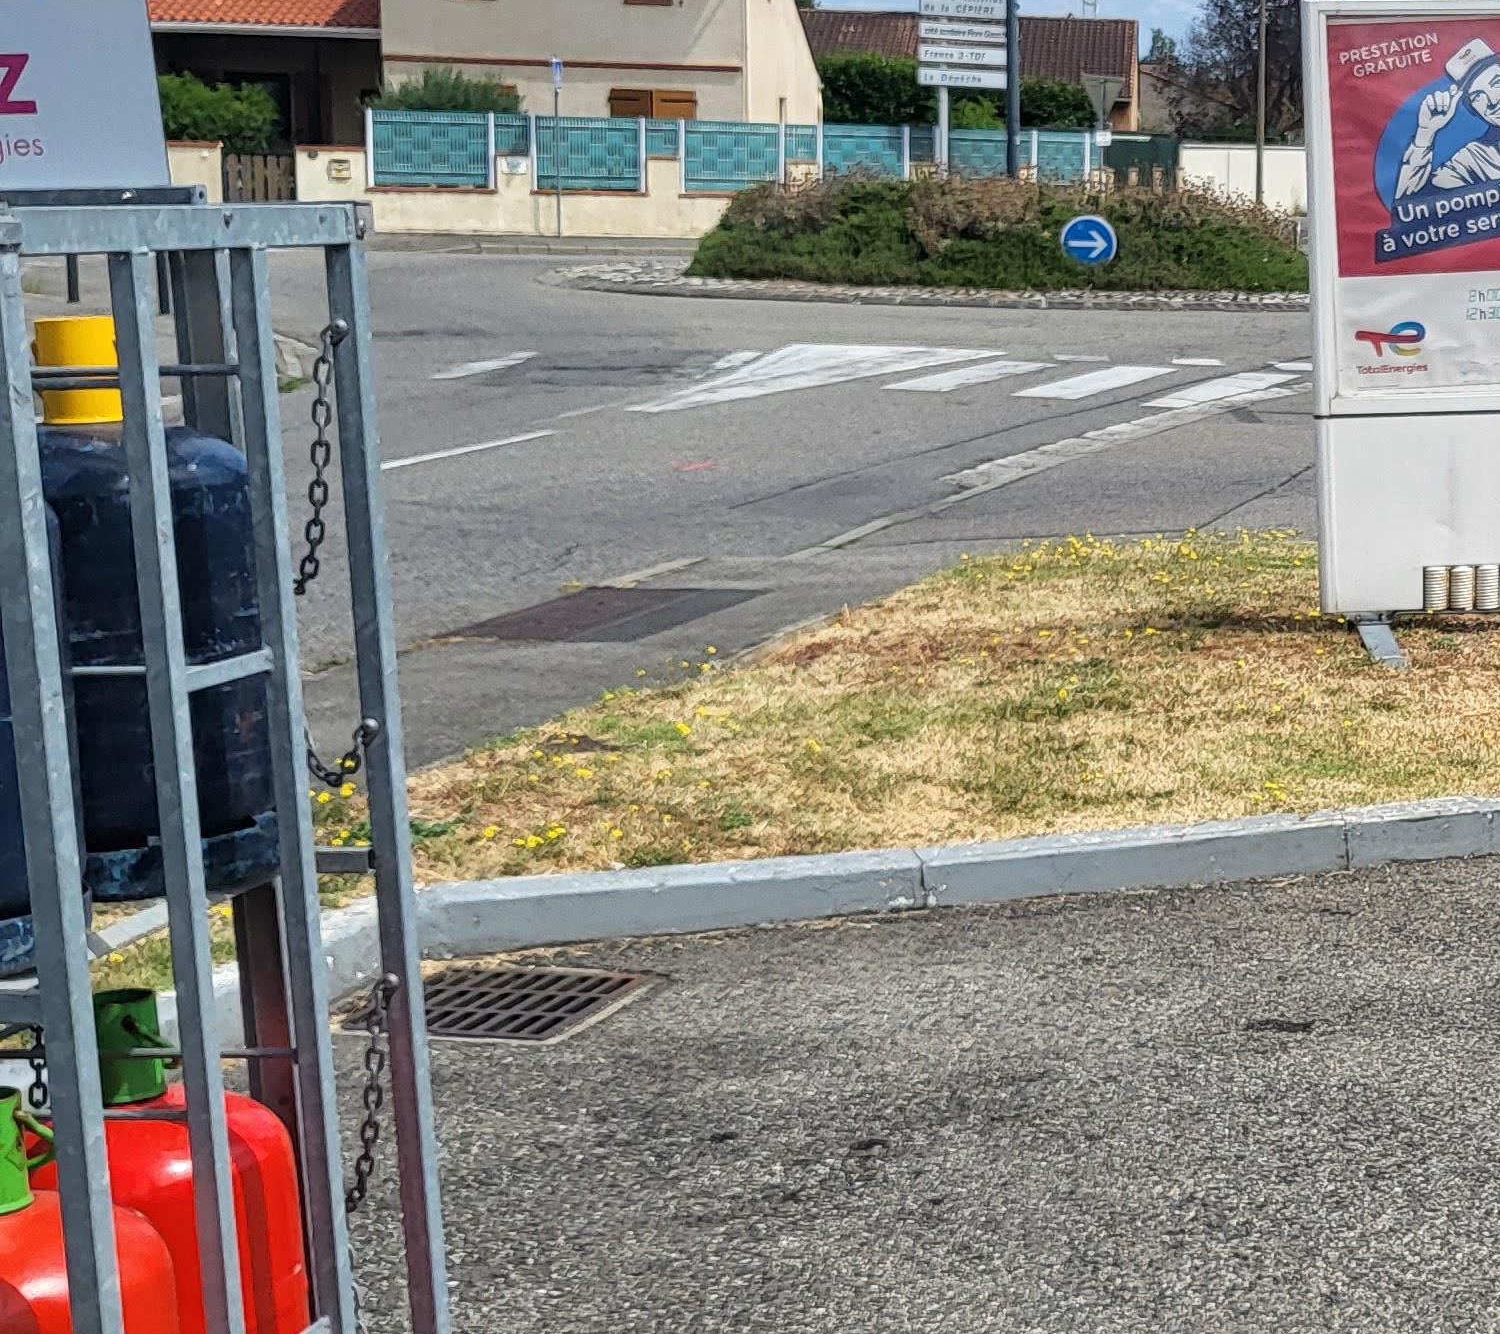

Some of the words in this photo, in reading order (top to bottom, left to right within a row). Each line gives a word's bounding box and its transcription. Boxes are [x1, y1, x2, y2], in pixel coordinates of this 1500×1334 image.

[924, 50, 955, 59] France
[1339, 32, 1439, 65] PRESTATION
[1353, 49, 1432, 77] GRATUITE
[1397, 203, 1430, 223] Un
[1382, 233, 1397, 253] à
[1401, 224, 1461, 249] votre
[1355, 362, 1429, 375] TotalEnergies
